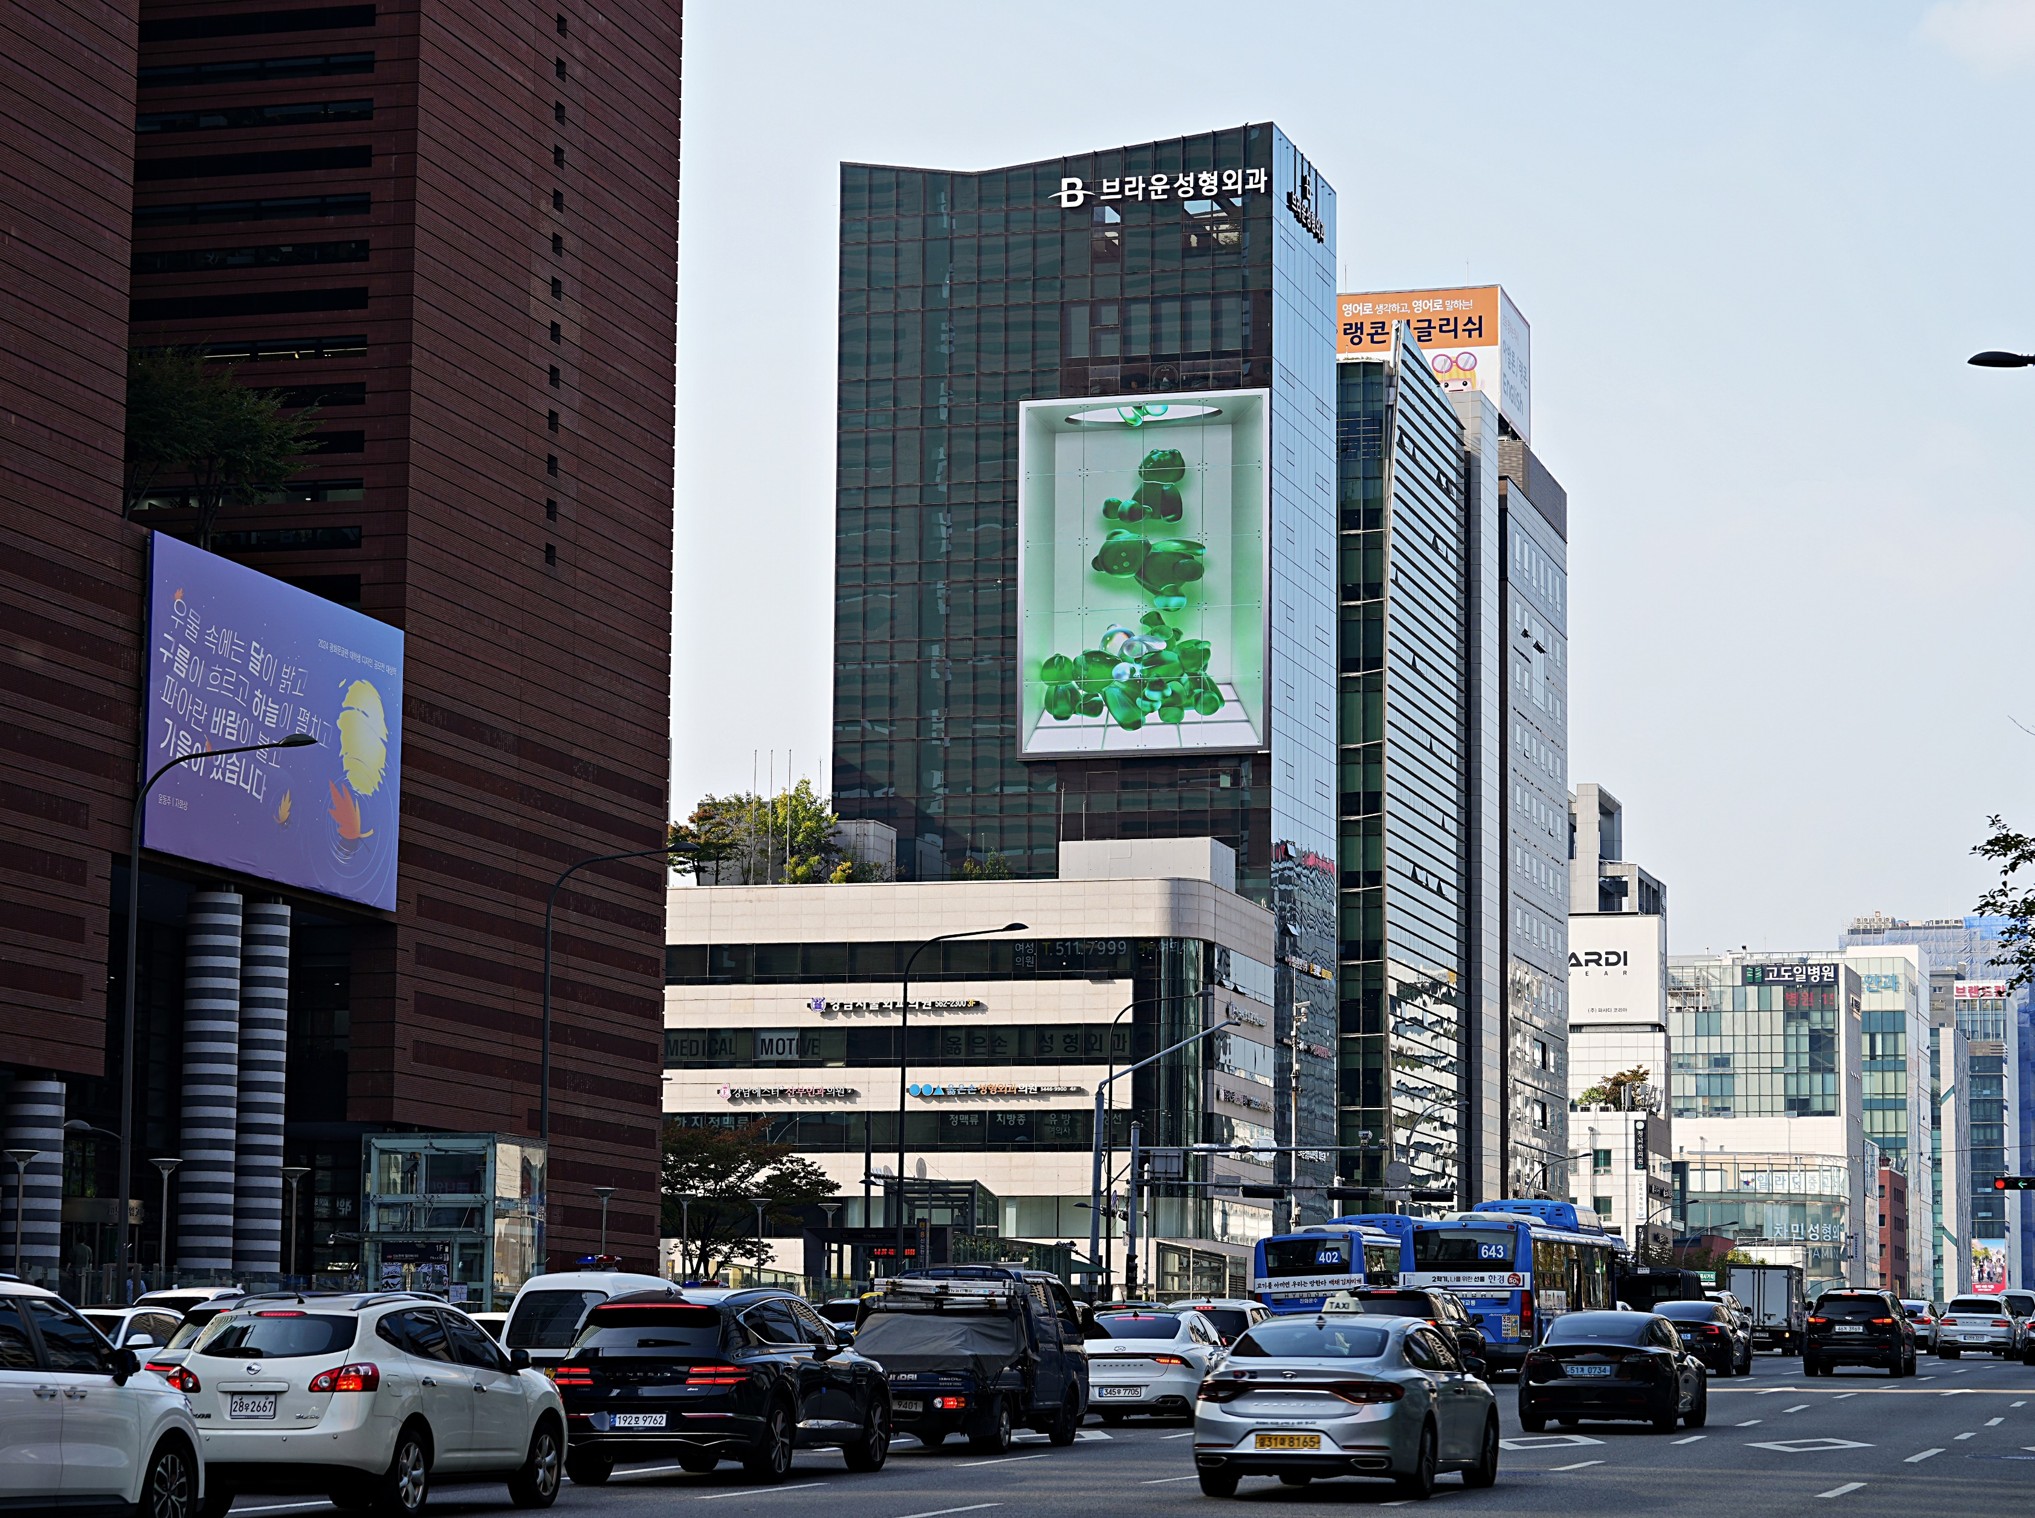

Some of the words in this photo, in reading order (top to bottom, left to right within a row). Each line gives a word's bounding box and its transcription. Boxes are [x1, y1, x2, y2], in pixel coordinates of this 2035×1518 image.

[1099, 167, 1268, 201] 브라운성형외과
[1342, 303, 1374, 317] 영어로
[1374, 303, 1411, 315] 생각하고,
[1412, 299, 1443, 314] 영어로
[1445, 299, 1473, 312] 말하는!
[1343, 315, 1483, 346] 랭콘글리쉬
[171, 598, 201, 644] 우물
[205, 625, 246, 664] 속에는
[249, 640, 278, 687] 달이
[278, 663, 309, 698] 밝고
[159, 633, 205, 688] 구름이
[206, 664, 250, 708] 흐르고
[252, 689, 294, 731] 하늘이
[160, 675, 208, 733] 파아란
[210, 706, 254, 746] 바람이
[159, 717, 207, 777] 가을이
[210, 749, 268, 804] 있습니다
[1014, 943, 1035, 954] 여성
[1015, 956, 1035, 968] 의원
[1765, 965, 1835, 982] 고도일병원
[1786, 992, 1814, 1007] 병원
[666, 1039, 735, 1056] MEDICAL
[760, 1037, 820, 1056] MOTIVE
[1041, 1033, 1127, 1054] 성형외과
[949, 1113, 979, 1126] 정맥류
[996, 1113, 1027, 1126] 지방종
[1318, 1251, 1339, 1263] 402
[1481, 1244, 1504, 1258] 643
[1329, 1301, 1350, 1310] TAXI
[1587, 1366, 1607, 1374] 0734
[1123, 1387, 1140, 1396] 7705
[232, 1400, 275, 1413] 28우2667
[897, 1401, 918, 1410] 9401
[642, 1415, 664, 1426] 9762
